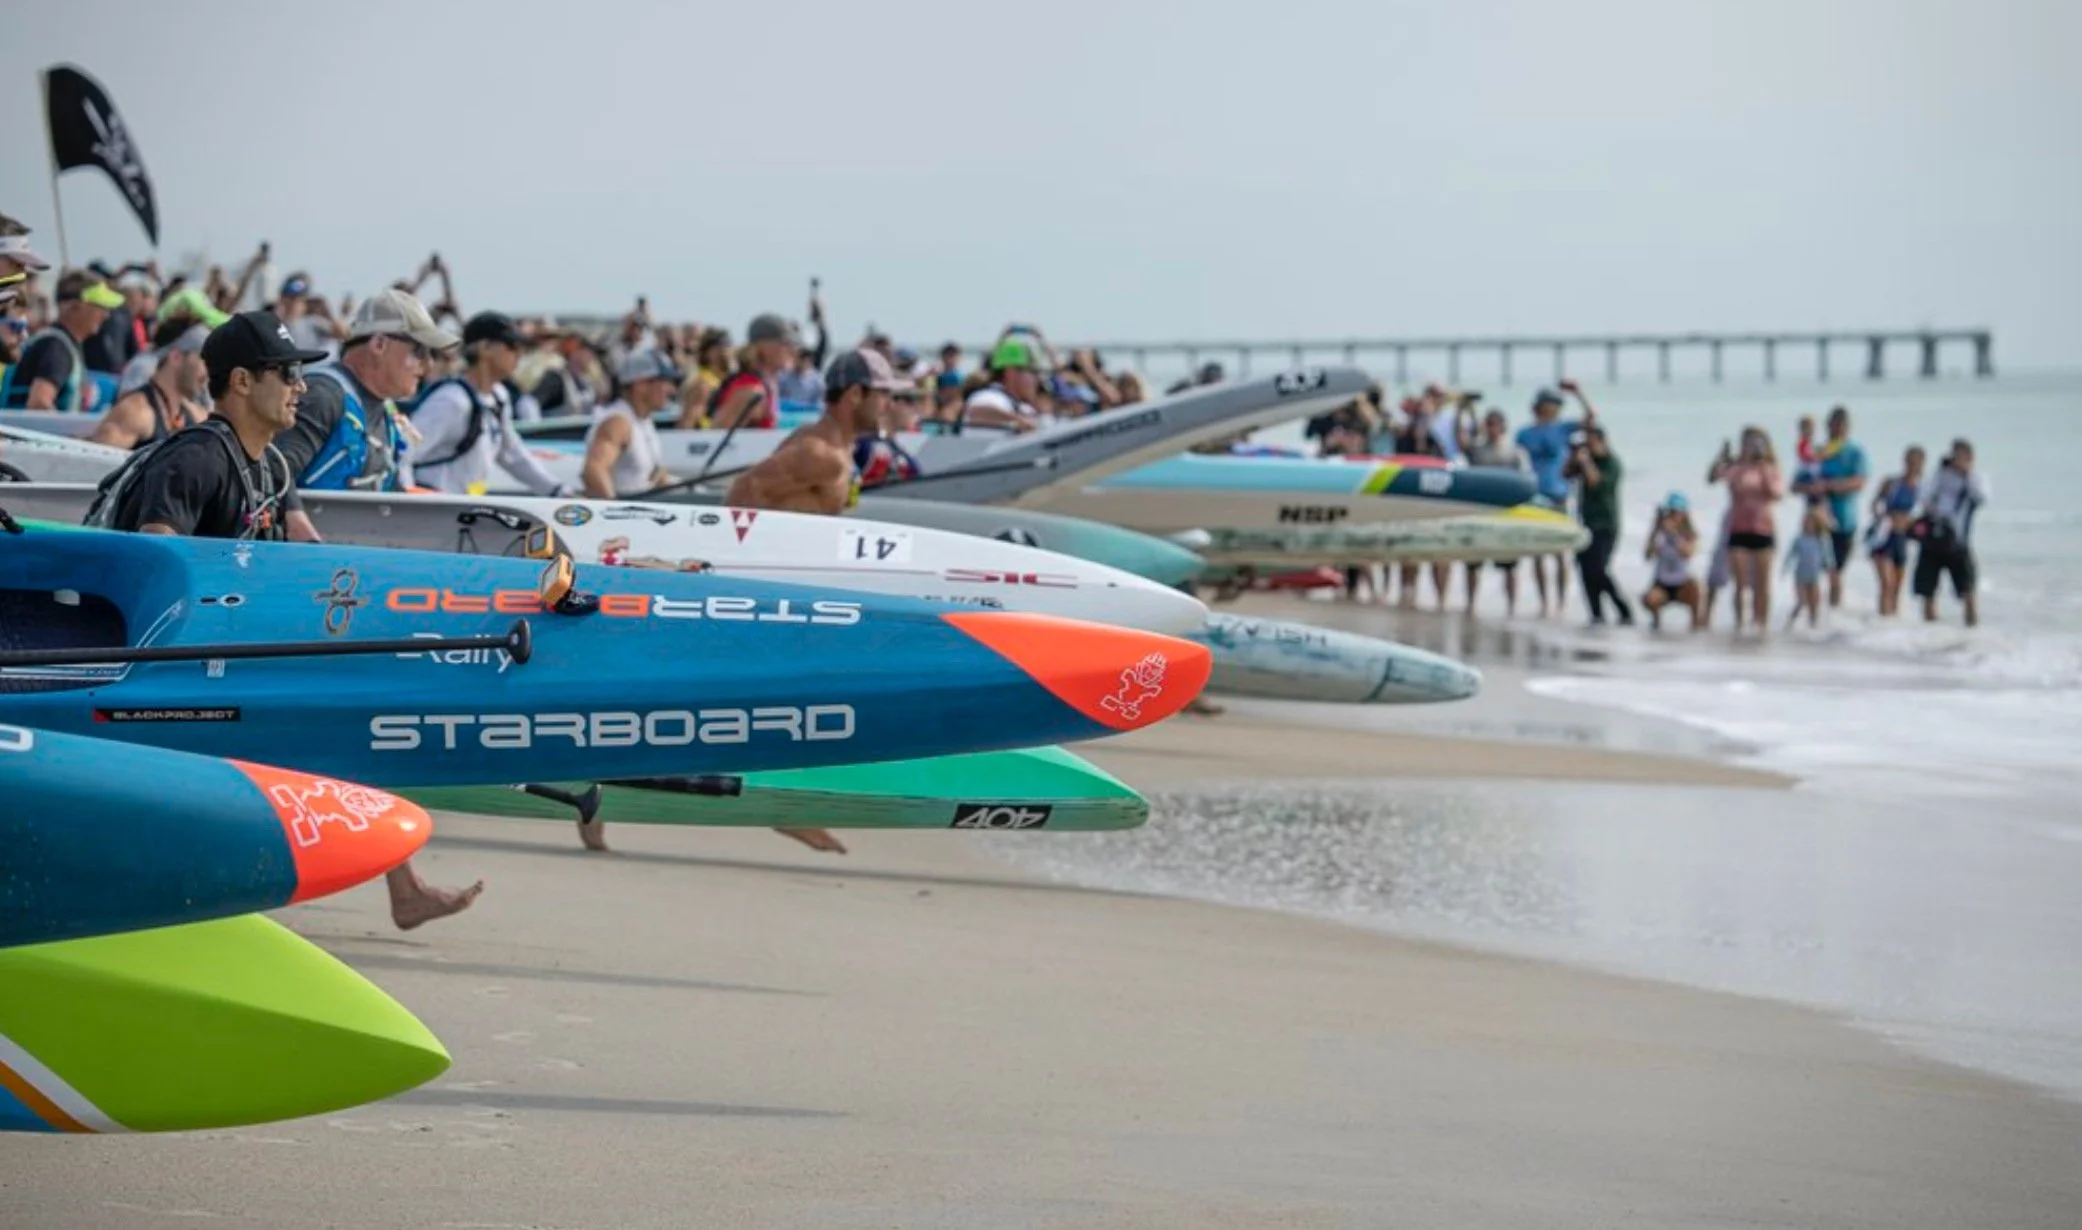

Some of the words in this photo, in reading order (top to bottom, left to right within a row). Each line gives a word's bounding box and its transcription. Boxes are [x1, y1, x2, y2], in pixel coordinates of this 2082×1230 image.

[1278, 504, 1349, 524] NSP
[856, 535, 898, 560] 41
[386, 588, 862, 626] STARBARD
[112, 709, 236, 721] BLACKPROJECT
[369, 703, 856, 751] STARBOARD
